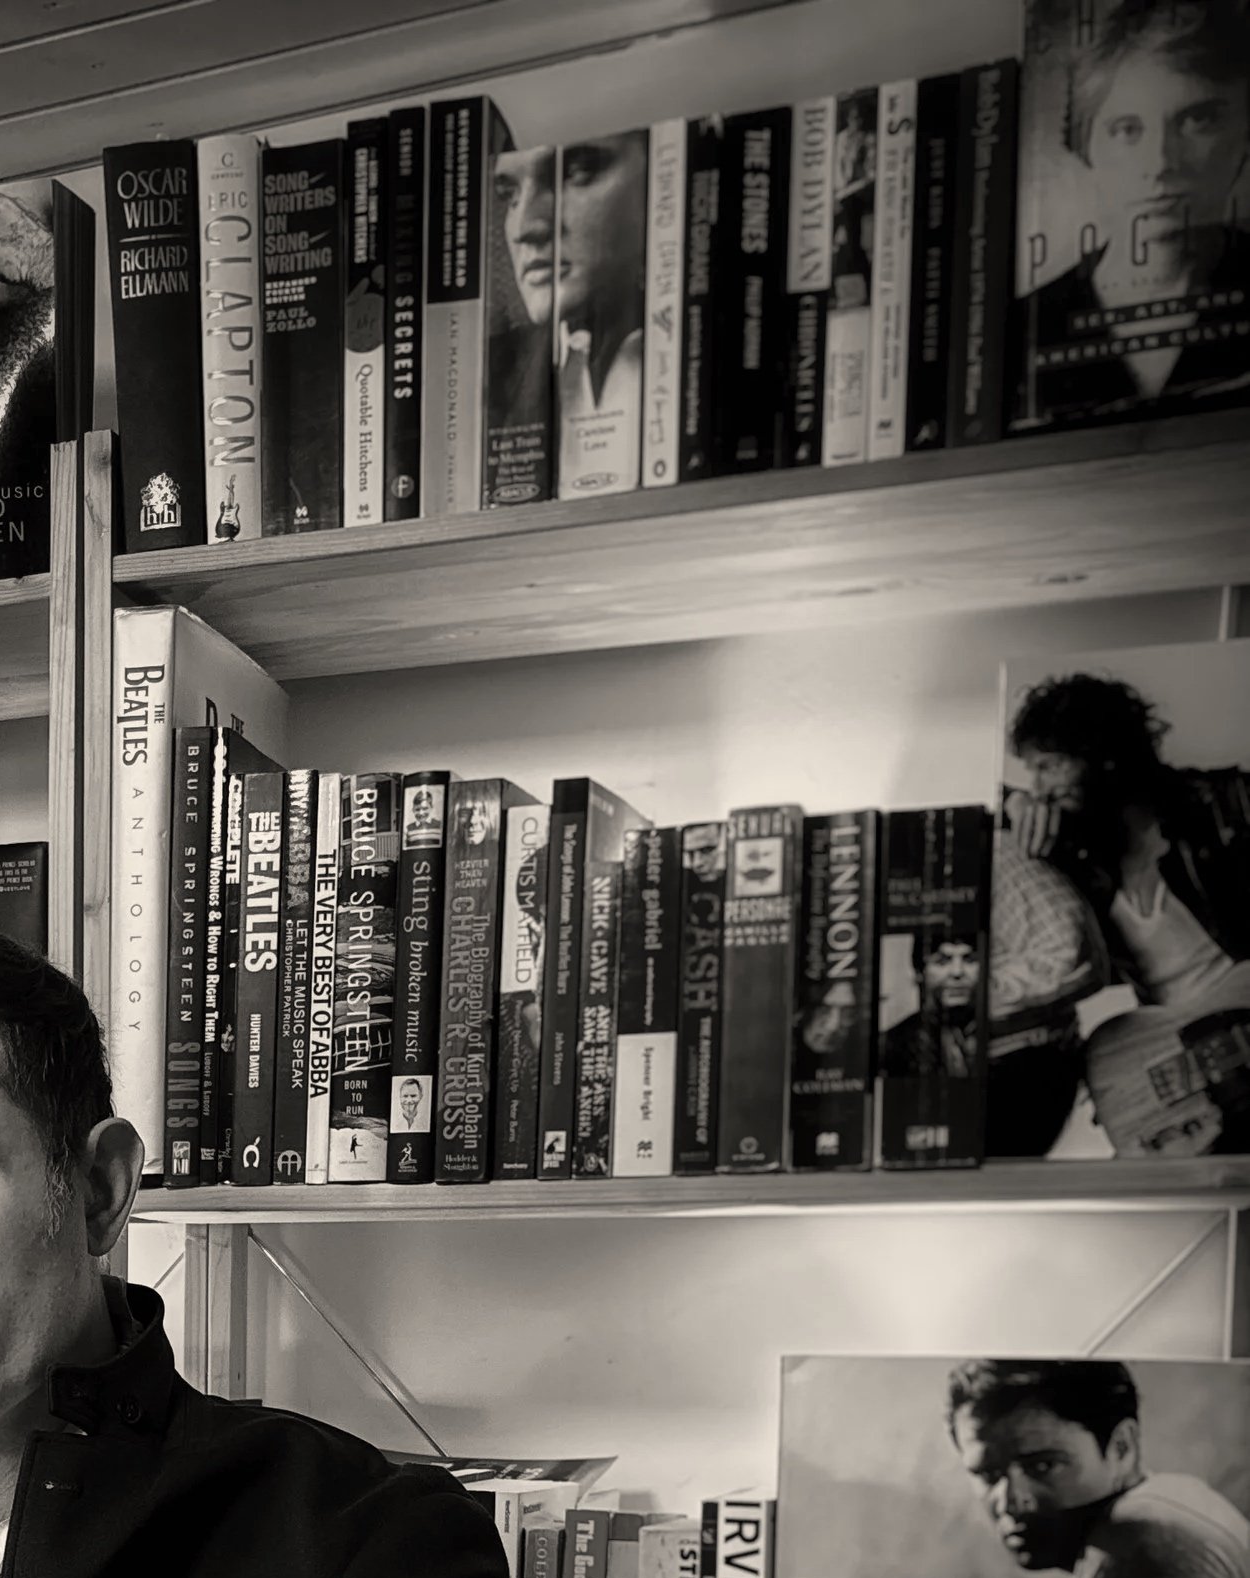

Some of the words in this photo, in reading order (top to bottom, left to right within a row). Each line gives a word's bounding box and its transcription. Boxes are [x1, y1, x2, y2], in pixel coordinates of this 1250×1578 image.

[744, 128, 771, 169] THE
[801, 107, 825, 168] BOB
[117, 167, 188, 199] OSCAR
[208, 191, 248, 211] ERIC
[264, 186, 336, 214] WRITERS
[122, 199, 183, 230] WILDE
[265, 217, 288, 234] ON
[741, 174, 768, 253] STONES
[799, 179, 823, 282] DYLAN
[120, 244, 188, 274] RICHARD
[120, 271, 189, 299] ELLMANN
[265, 247, 332, 275] WRITING
[265, 306, 309, 321] PAUL
[265, 316, 316, 333] ZOLLO
[204, 214, 256, 467] CLAPTON
[393, 295, 415, 400] SECRETS
[794, 294, 819, 432] CHRONICLES
[355, 363, 374, 428] Quotable
[359, 430, 374, 492] Hitchens
[121, 663, 165, 766] BEATLES
[154, 702, 165, 725] THE
[186, 745, 200, 824] BRUCE
[249, 811, 280, 832] THE
[350, 788, 378, 879] BRUCE
[317, 849, 337, 890] THE
[518, 816, 539, 887] CURTIS
[645, 836, 663, 881] peter
[128, 787, 144, 1033] ANTHOLOGY
[244, 831, 281, 973] BEATLES
[403, 861, 435, 933] sting
[643, 888, 664, 950] gabriel
[827, 825, 860, 979] LENNON
[180, 846, 197, 1023] SPRINGSTEEN
[293, 919, 308, 947] LET
[314, 896, 336, 954] VERY
[471, 914, 491, 942] The
[515, 890, 534, 984] MAYFIELD
[292, 951, 307, 982] THE
[407, 940, 429, 1003] broken
[447, 896, 475, 1012] CHARLES
[684, 892, 720, 1011] CASH
[312, 957, 334, 1009] BEST
[344, 890, 374, 1072] SPRINGSTEEN
[464, 946, 489, 1028] Biography
[248, 1013, 262, 1051] HUNTER
[292, 986, 307, 1033] MUSIC
[311, 1012, 332, 1038] OF
[404, 1009, 423, 1062] music
[445, 1022, 470, 1047] R.
[290, 1038, 306, 1090] SPEAK
[468, 1032, 486, 1048] of
[554, 1032, 565, 1050] John
[166, 1040, 199, 1129] SONGS
[247, 1054, 260, 1089] DAVIES
[308, 1040, 329, 1098] ABBA
[344, 1080, 368, 1090] BORN
[465, 1053, 487, 1088] Kurt
[552, 1052, 564, 1085] Stevens
[346, 1105, 364, 1115] RUN
[351, 1092, 362, 1103] TO
[441, 1056, 466, 1140] CROSS
[462, 1092, 484, 1149] Cobain
[576, 1520, 595, 1554] The
